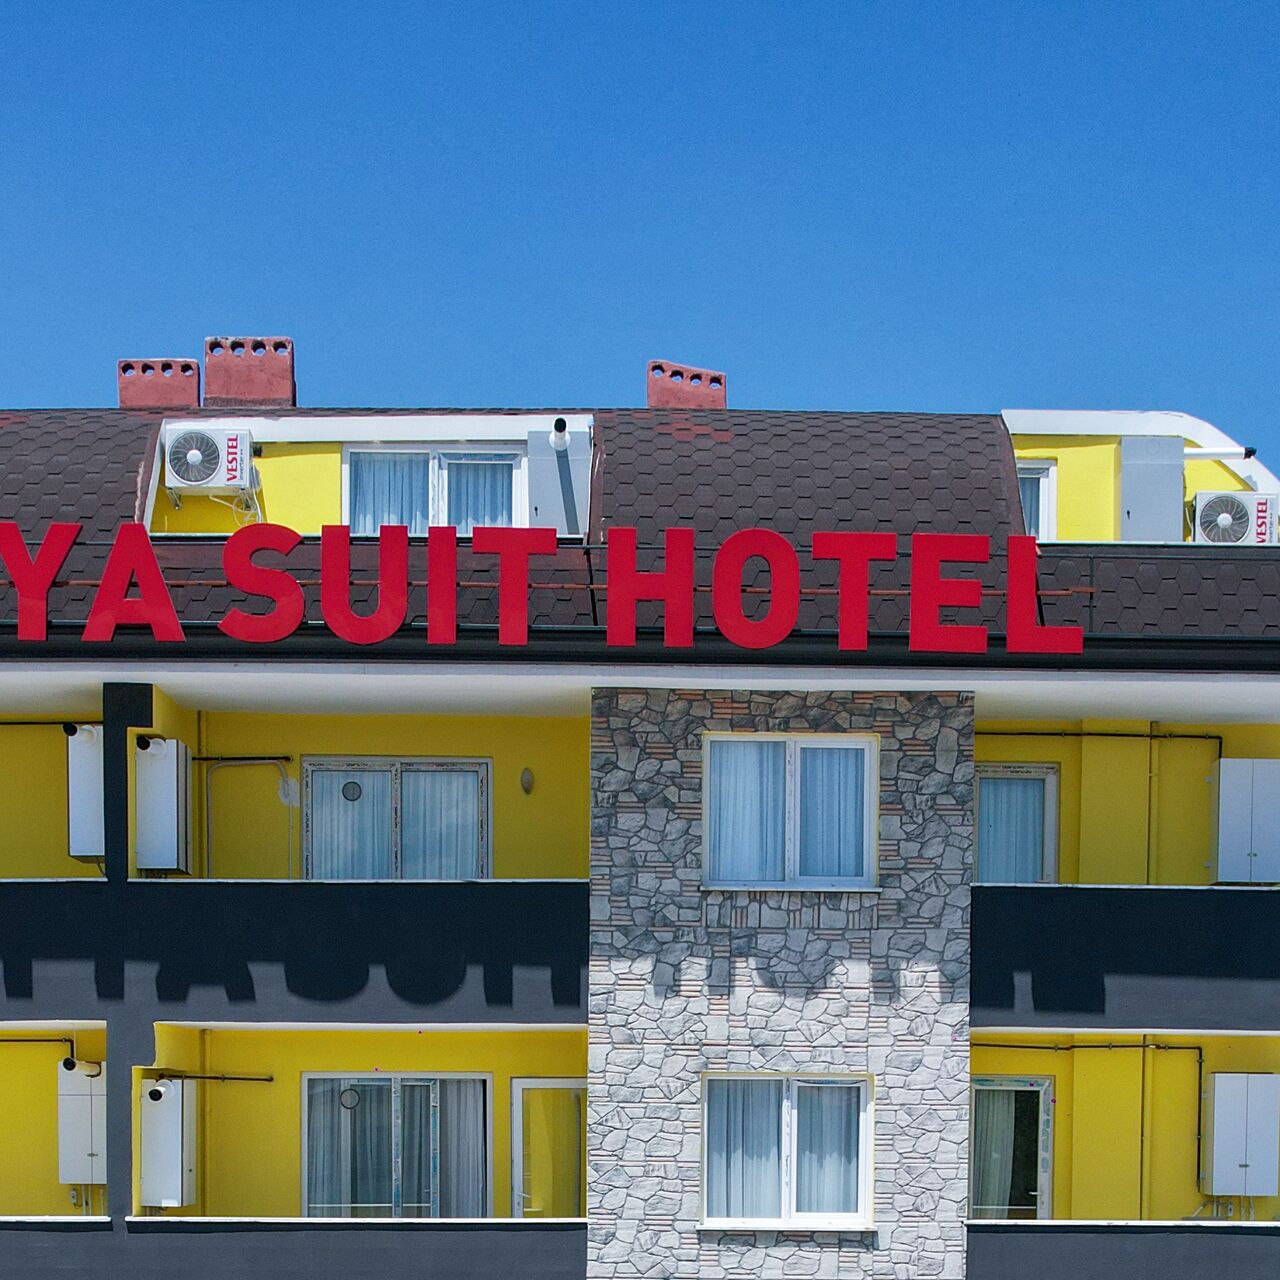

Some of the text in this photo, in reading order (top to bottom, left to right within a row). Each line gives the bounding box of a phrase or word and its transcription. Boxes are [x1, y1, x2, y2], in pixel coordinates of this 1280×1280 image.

[227, 434, 238, 482] VESTEL
[1256, 499, 1267, 544] VESTEL
[218, 523, 557, 645] SUIT
[606, 526, 1084, 654] HOTEL
